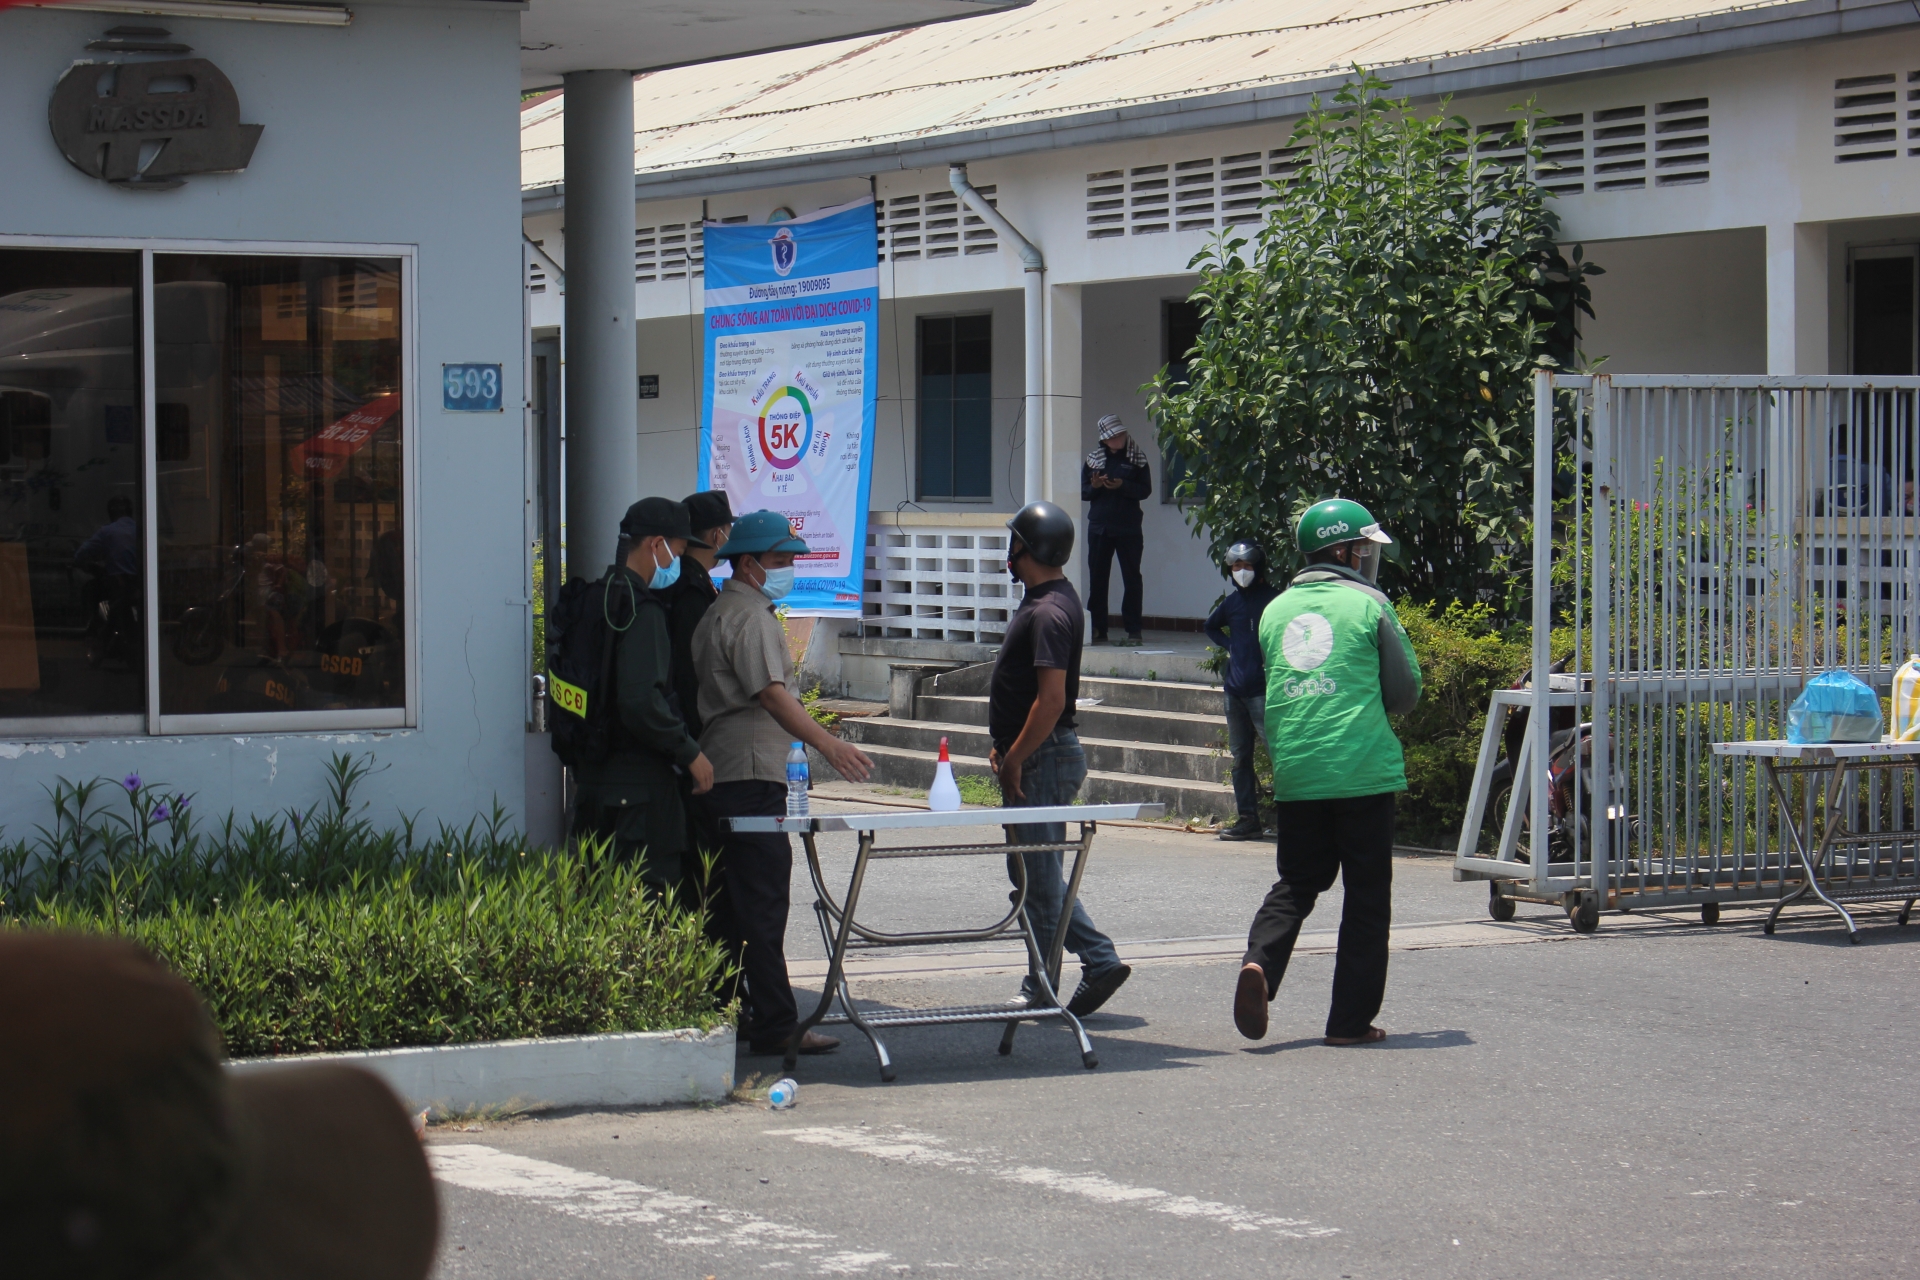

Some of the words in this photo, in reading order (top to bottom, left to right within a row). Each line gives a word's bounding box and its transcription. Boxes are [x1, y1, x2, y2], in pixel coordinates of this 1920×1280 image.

[90, 104, 208, 132] MASSDA
[798, 278, 830, 293] 19009095
[710, 314, 736, 329] CHUNG
[737, 308, 758, 326] SỐNG
[759, 310, 770, 324] AN
[770, 307, 791, 323] TOÀN
[791, 304, 804, 320] VỚI
[804, 305, 818, 323] ĐẠI
[819, 302, 836, 321] DỊCH
[838, 298, 871, 314] COVID-19
[448, 368, 497, 398] 593
[762, 371, 777, 390] TRANG
[790, 412, 801, 422] ĐIỆP
[771, 423, 799, 450] 5K
[772, 472, 784, 482] KHAI
[782, 482, 788, 493] TẾ
[1316, 520, 1349, 538] Grab
[818, 580, 846, 590] COVID-19
[321, 654, 362, 676] CSCĐ
[1284, 672, 1336, 698] Grab
